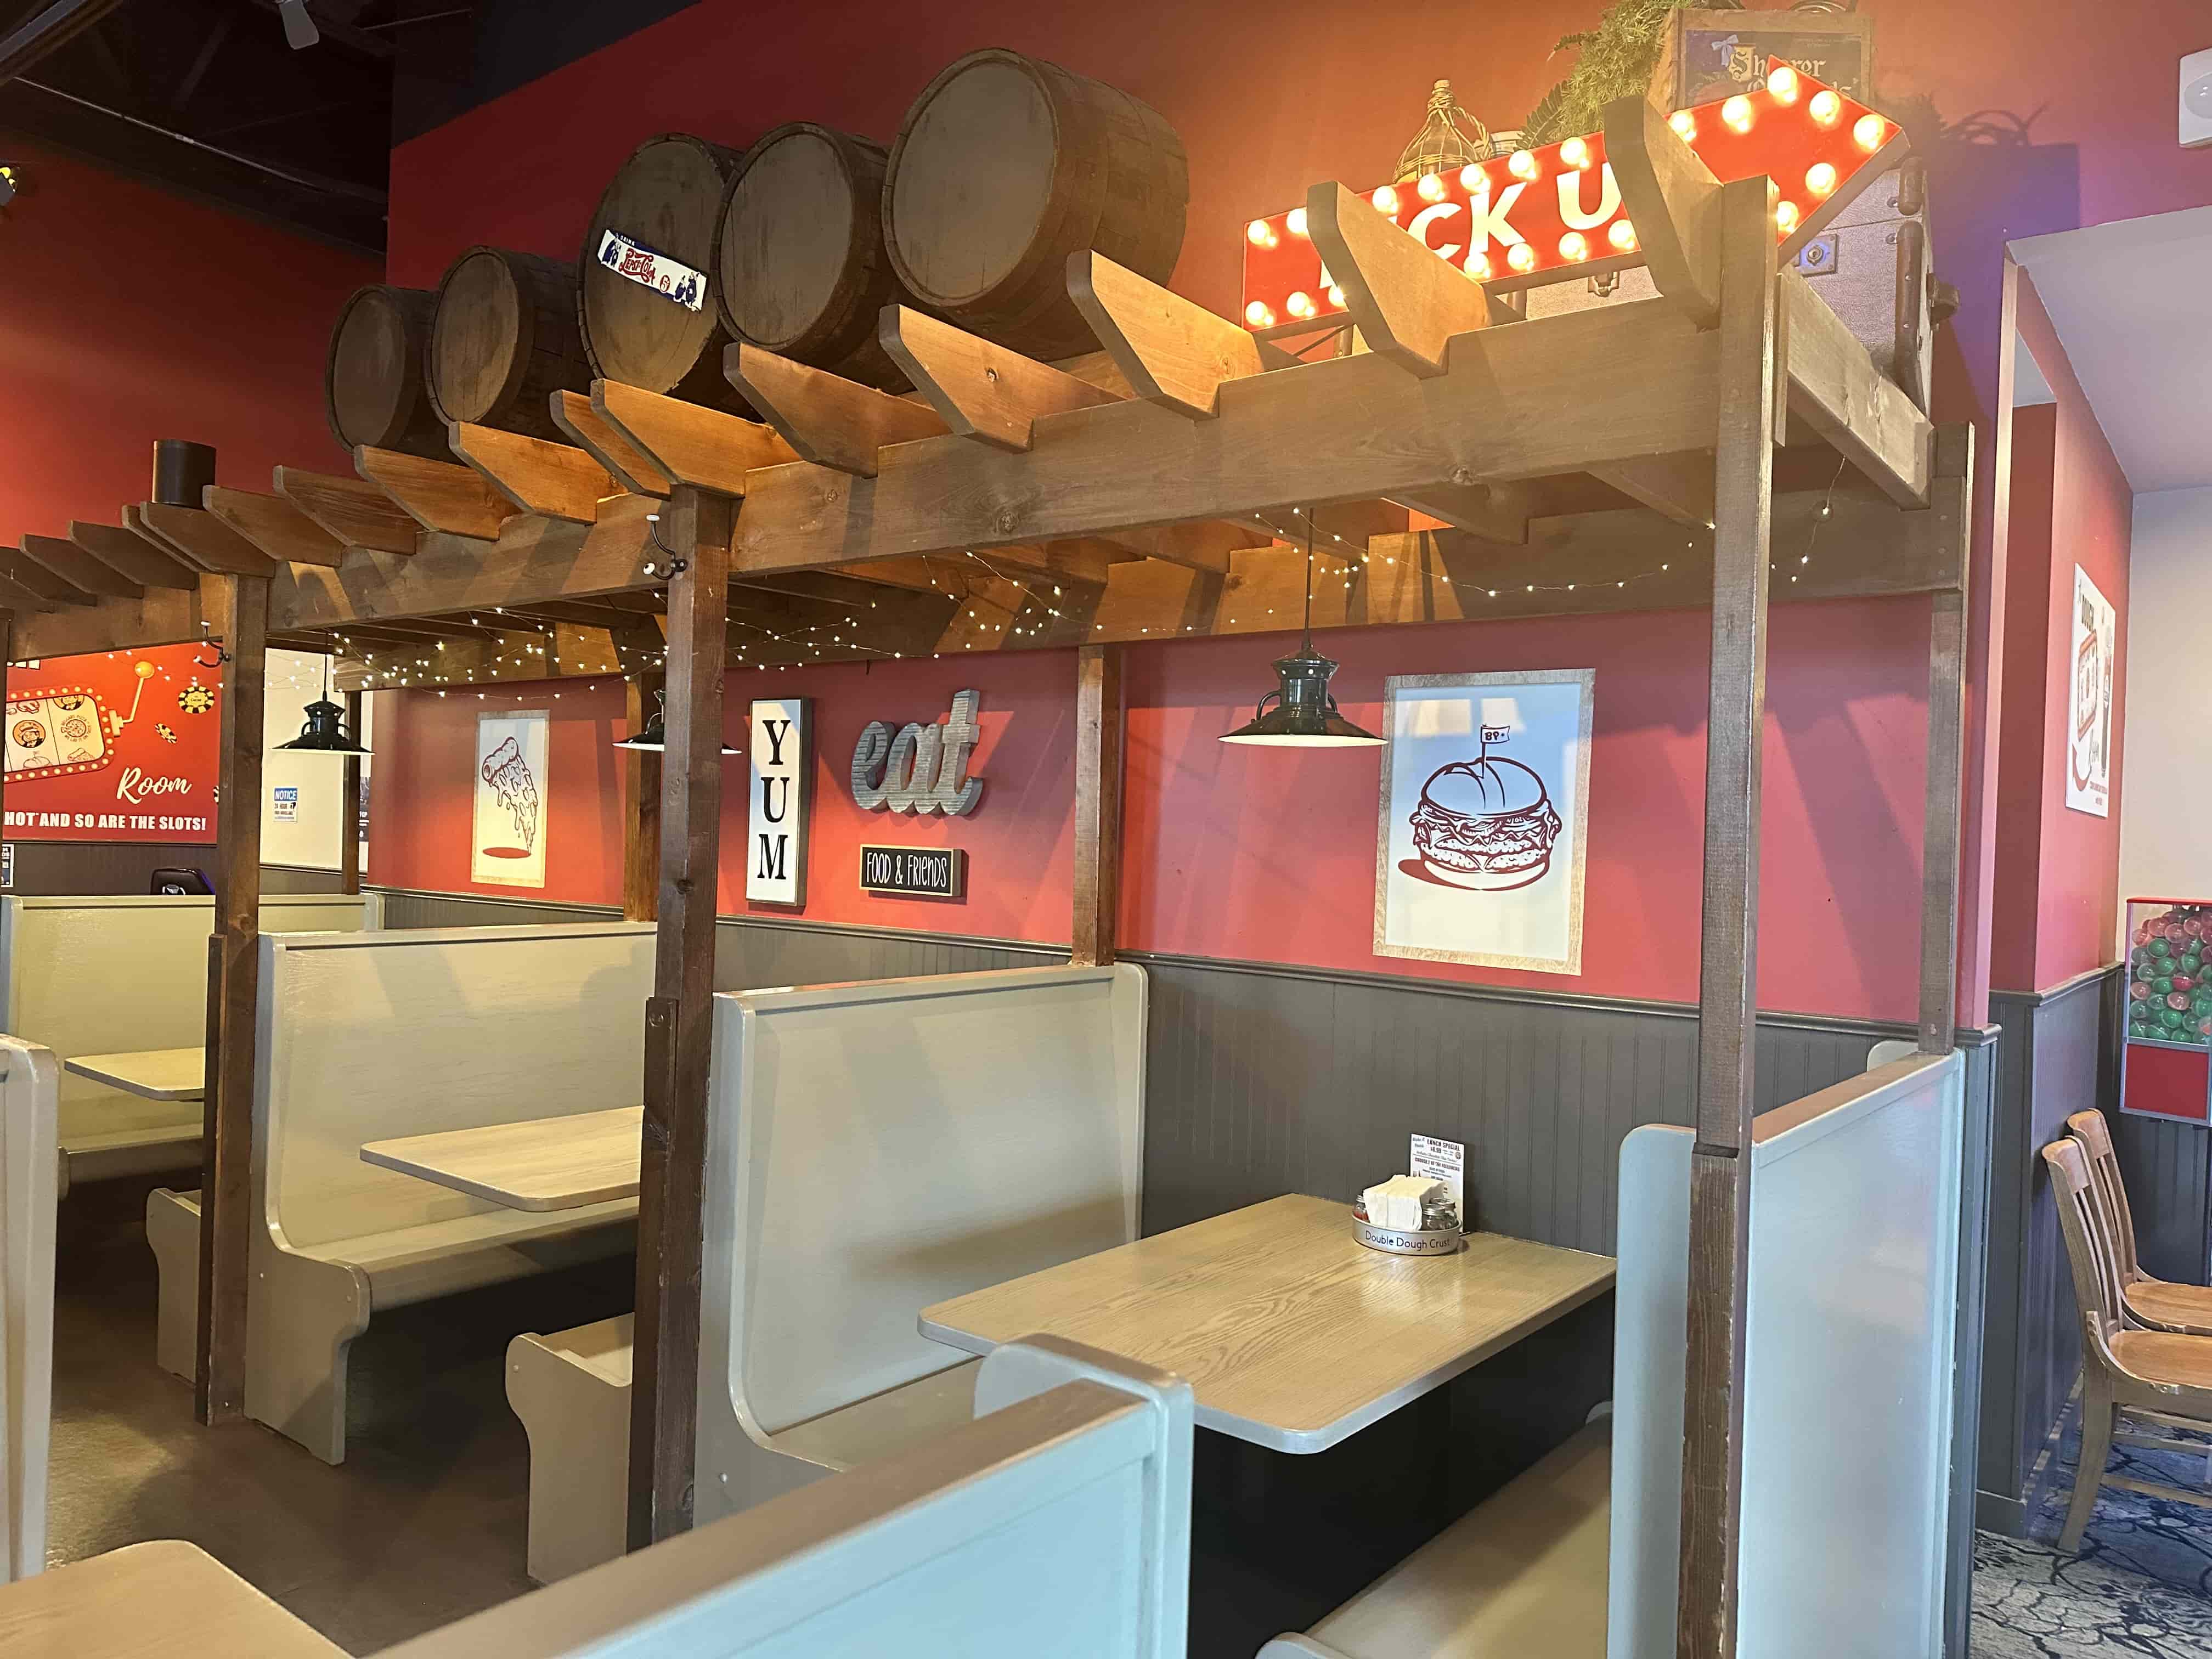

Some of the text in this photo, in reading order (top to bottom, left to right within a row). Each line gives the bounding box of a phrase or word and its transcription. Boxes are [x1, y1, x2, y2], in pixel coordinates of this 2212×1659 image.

[1556, 162, 1622, 230] U
[851, 689, 983, 816] eat
[116, 767, 191, 804] Room
[275, 790, 297, 800] NOTICE
[757, 720, 791, 879] YUM
[39, 813, 70, 827] AND
[75, 814, 94, 828] SO
[98, 815, 126, 828] ARE
[129, 815, 155, 830] THE
[159, 816, 207, 831] SLOTS!
[867, 852, 891, 884] FOOD
[896, 855, 903, 884] &
[1365, 1231, 1449, 1251] Double Dough Crust
